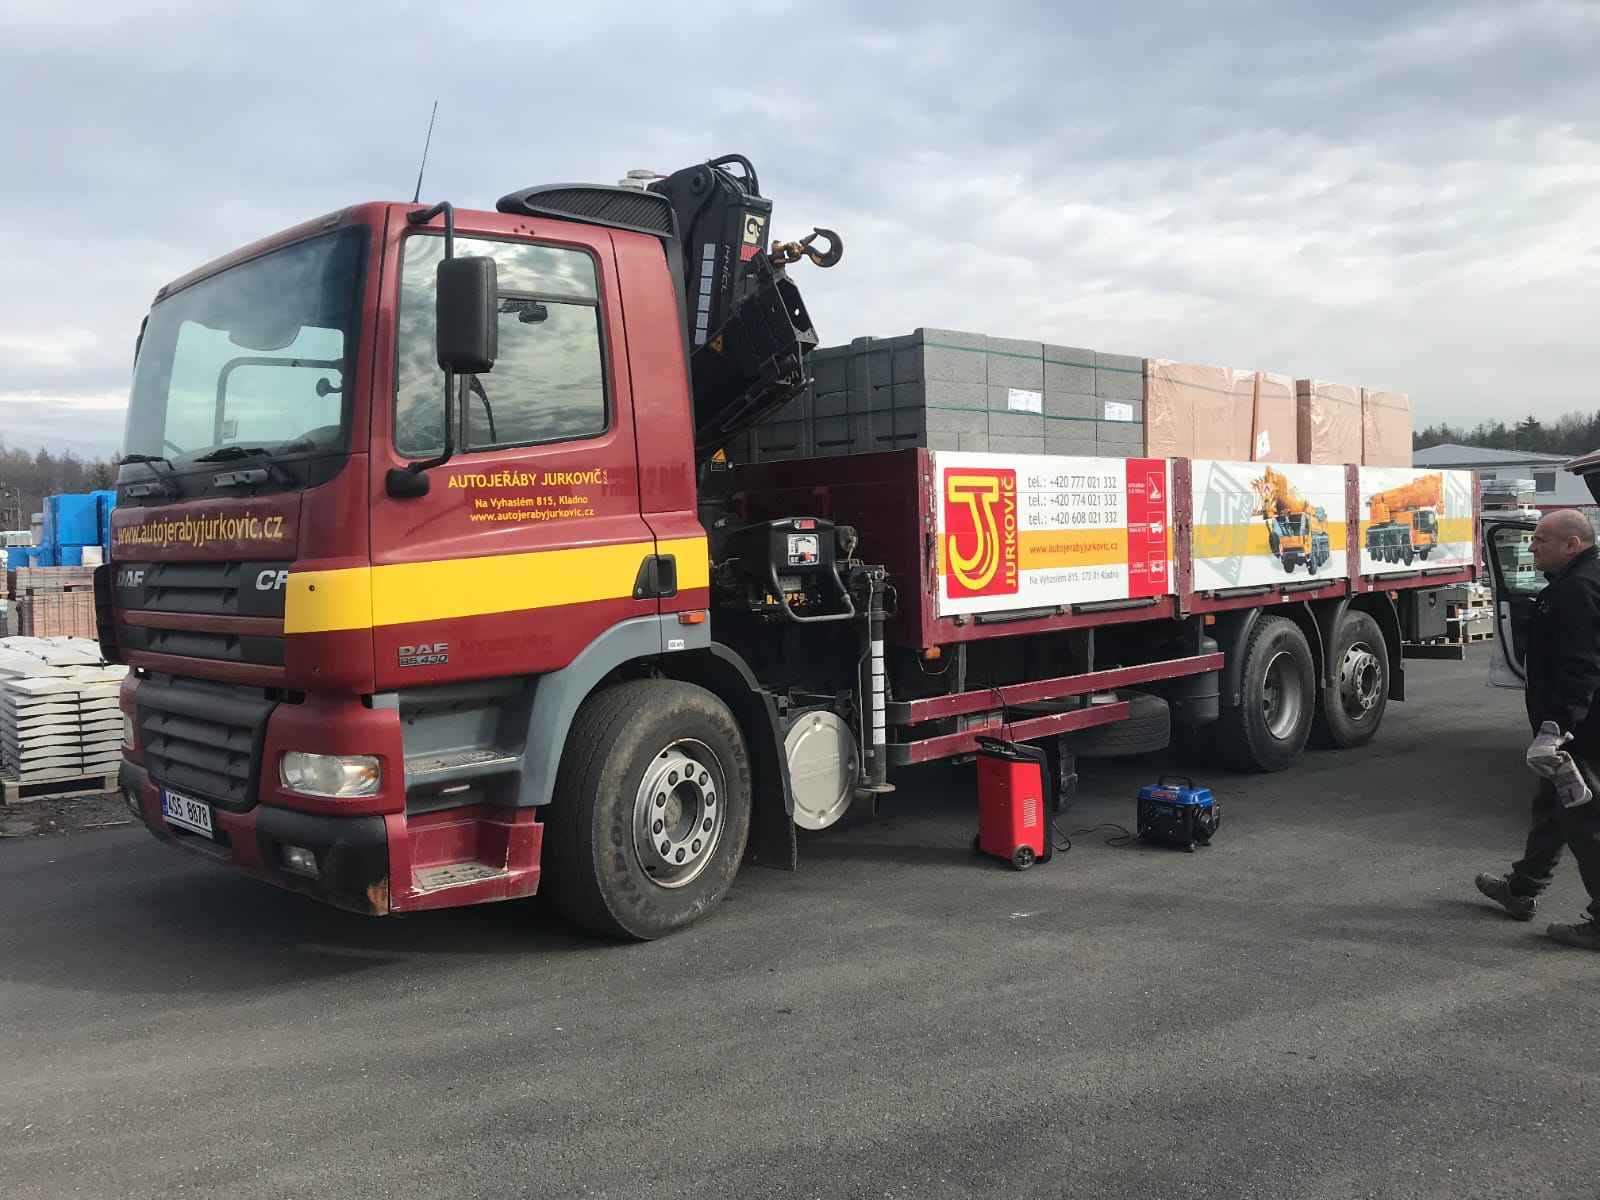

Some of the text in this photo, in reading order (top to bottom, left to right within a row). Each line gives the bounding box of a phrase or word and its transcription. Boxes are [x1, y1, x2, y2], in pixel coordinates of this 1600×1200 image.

[448, 470, 537, 489] AUTOJEŘÁBY
[541, 468, 602, 486] JURKOVIČ
[1050, 475, 1069, 488] +420
[1071, 475, 1086, 489] 777
[1087, 476, 1100, 489] 021
[1103, 476, 1117, 489] 332
[475, 495, 588, 510] Na Vyhaslém 815, Kladno
[1050, 493, 1069, 506] +420
[1071, 493, 1086, 506] 774
[1087, 493, 1101, 506] 021
[1104, 494, 1118, 506] 332
[470, 507, 595, 522] www.autojerabyjurkovic.cz
[1051, 511, 1070, 525] +420
[1071, 511, 1086, 524] 608
[1088, 511, 1101, 524] 021
[1104, 511, 1118, 523] 332
[117, 510, 283, 548] www.autojerabyjurkovic.cz
[1001, 476, 1016, 588] JURKOVIČ
[1029, 540, 1119, 555] www.autojerabyjurkovic.cz
[117, 570, 145, 587] DAF
[255, 570, 289, 590] CF
[398, 642, 449, 657] DAF
[168, 794, 183, 817] 4S5
[186, 801, 208, 827] 8878
